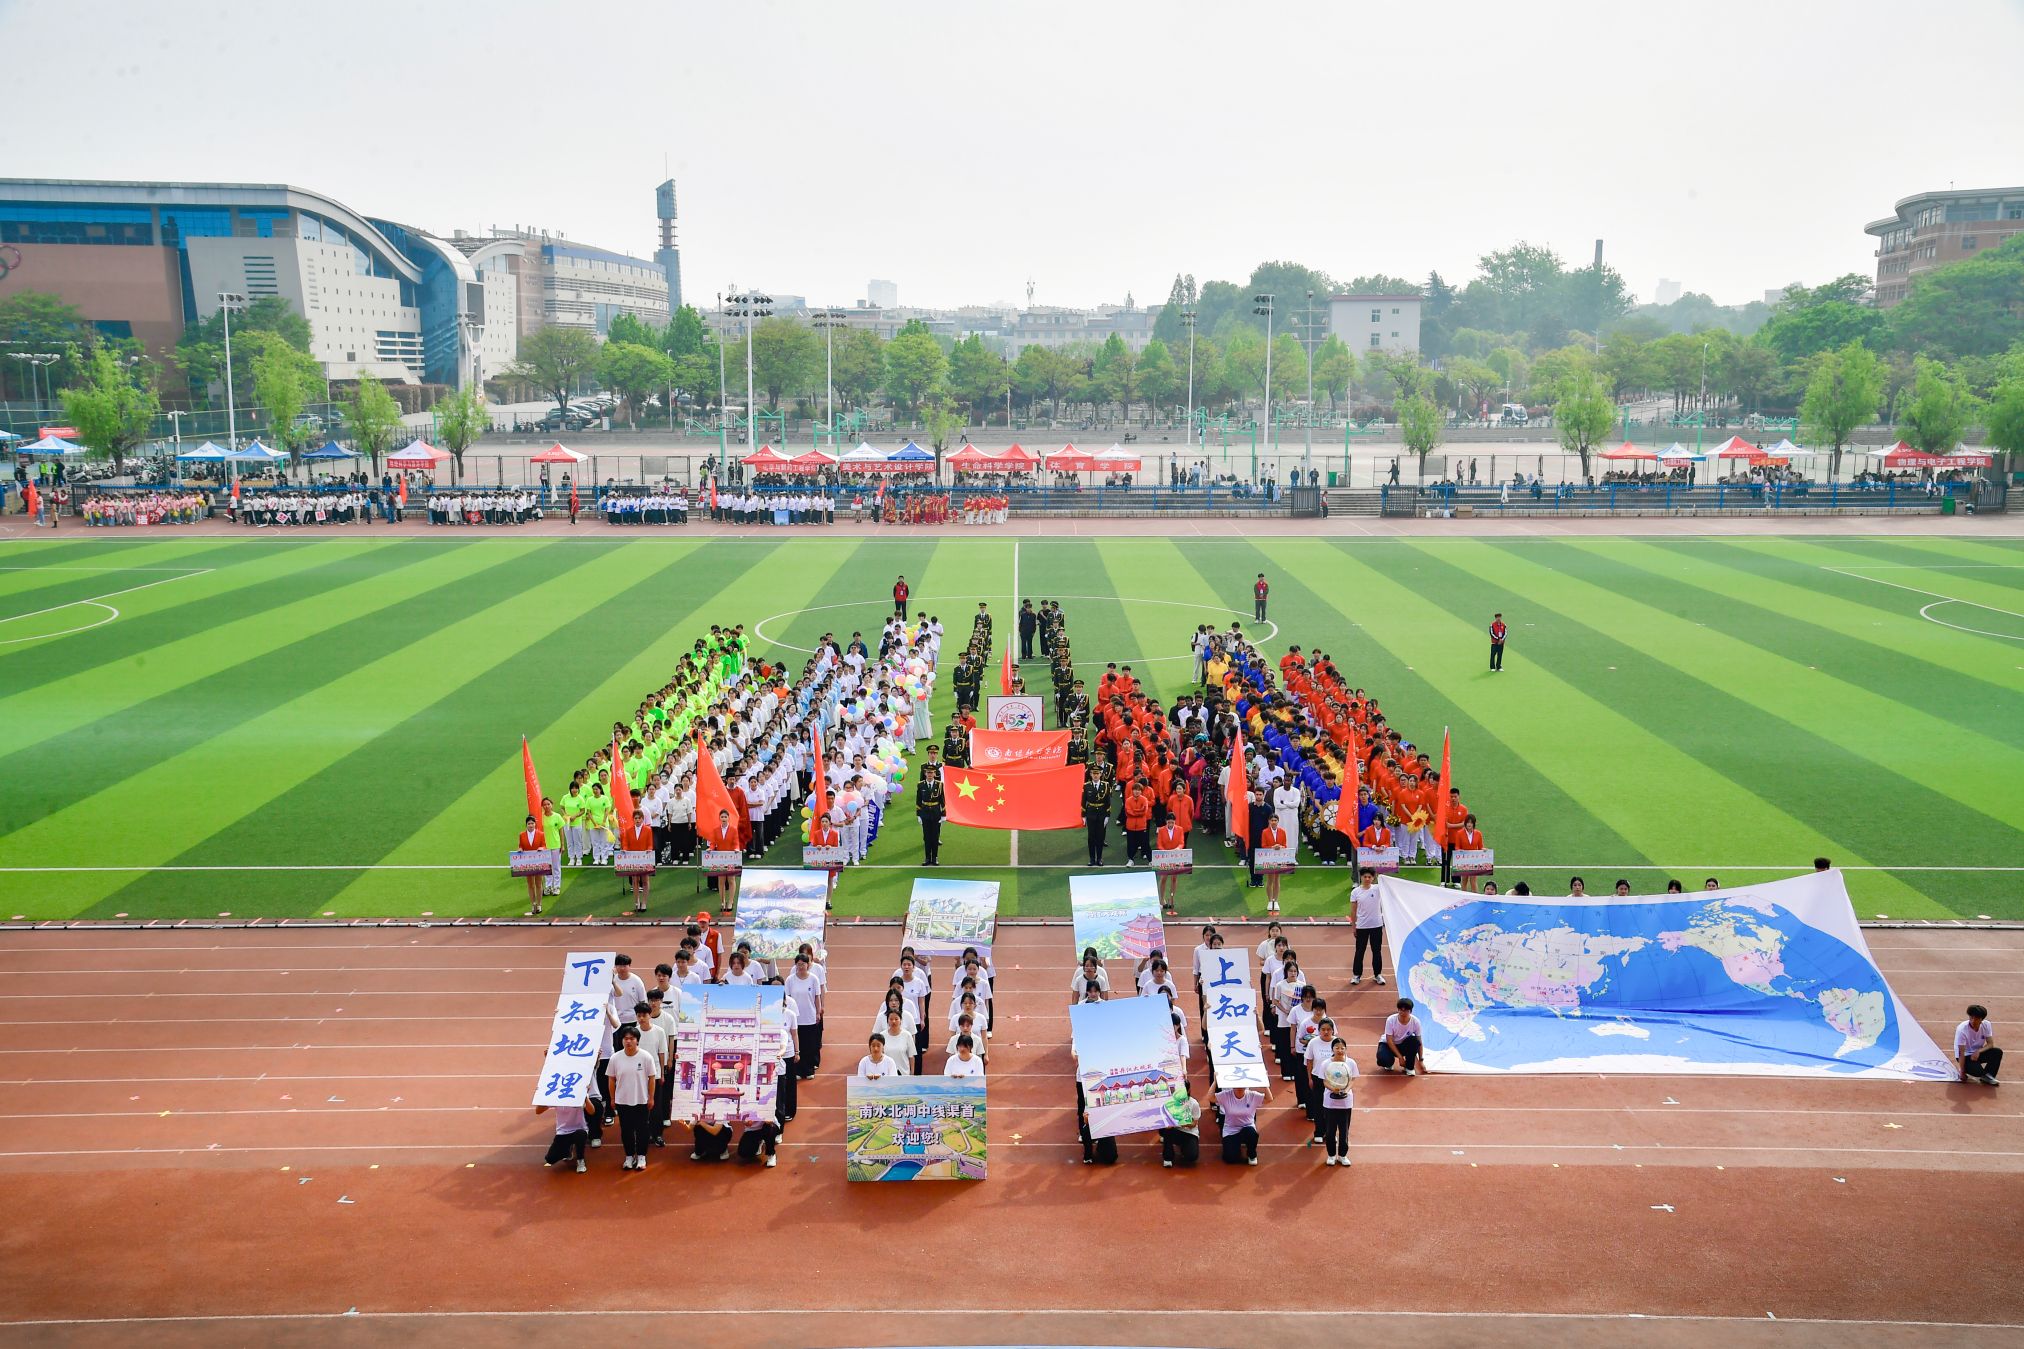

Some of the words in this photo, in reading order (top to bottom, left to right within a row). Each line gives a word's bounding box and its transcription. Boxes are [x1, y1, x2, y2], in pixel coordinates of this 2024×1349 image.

[842, 463, 934, 471] 美术与艺术设计学院
[1049, 461, 1134, 469] 体育学院
[1897, 457, 1986, 466] 物理与电子工程学院
[1210, 956, 1262, 1083] 上知天文
[545, 957, 606, 1100] 下知地理
[859, 1104, 975, 1119] 南水北调中线渠首
